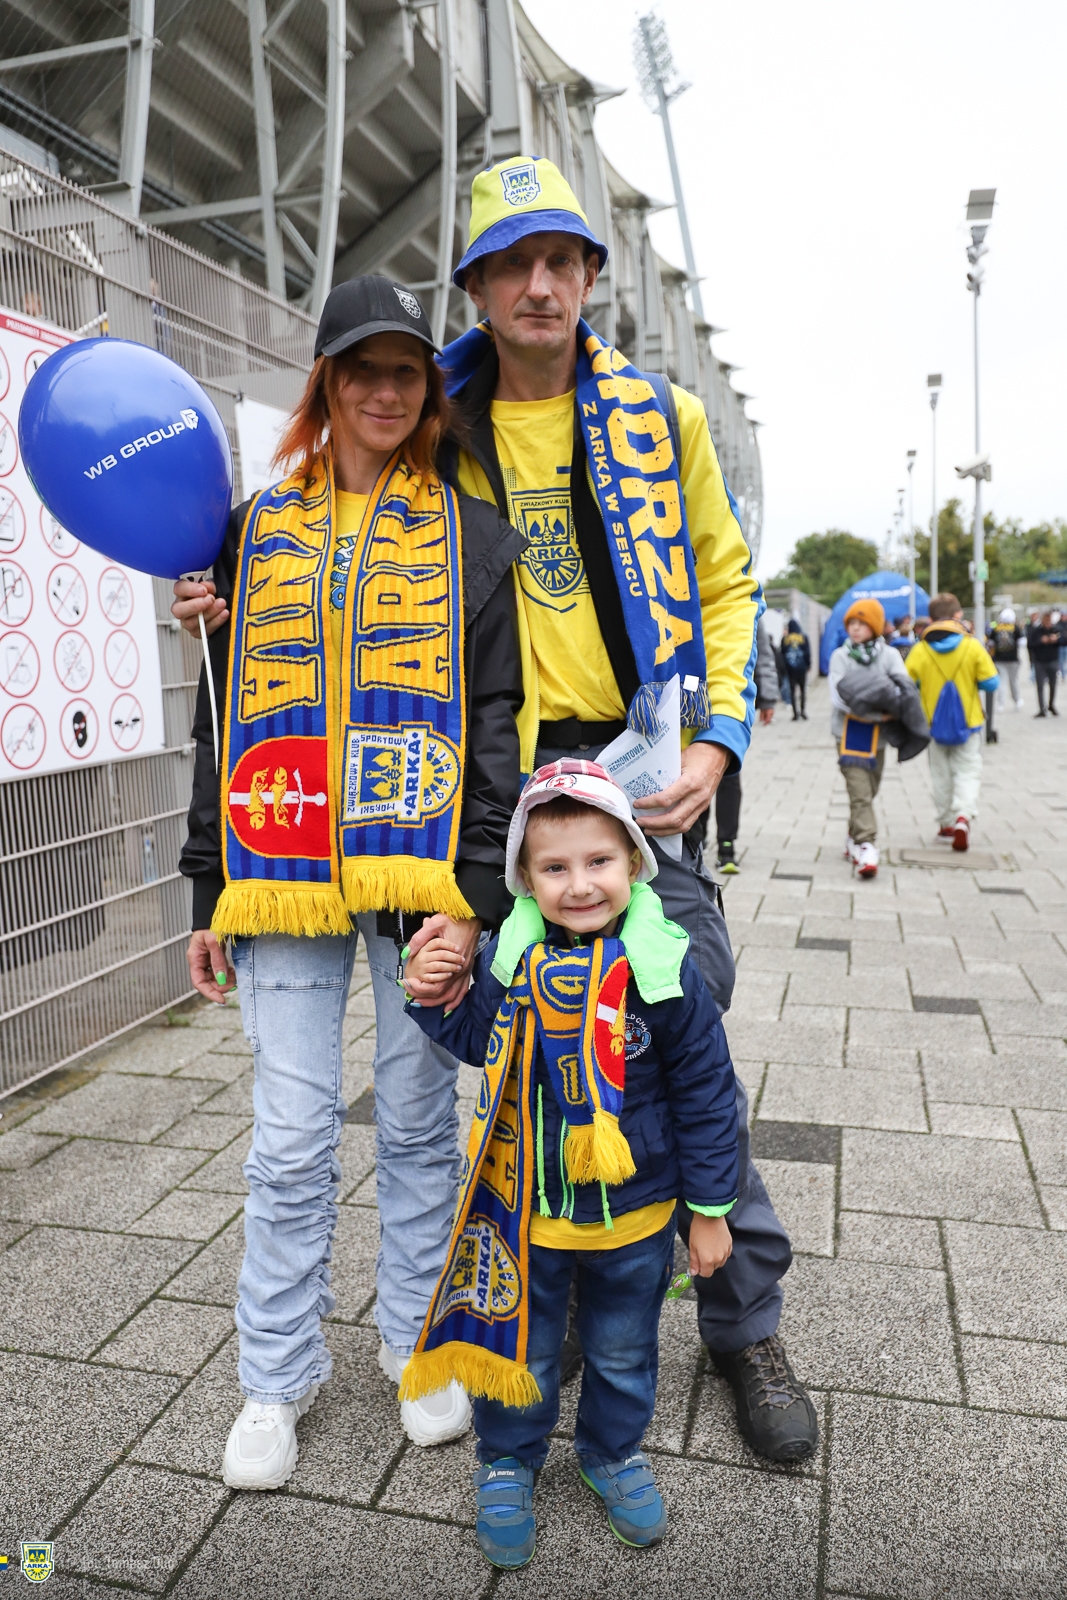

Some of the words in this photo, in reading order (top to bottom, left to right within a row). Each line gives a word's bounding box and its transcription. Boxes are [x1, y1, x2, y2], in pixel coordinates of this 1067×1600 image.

[510, 186, 535, 196] ARKA
[582, 400, 599, 417] Z
[83, 454, 118, 480] WB
[119, 421, 187, 459] GROUP
[586, 424, 614, 491] ARKĄ
[520, 499, 554, 507] ZWIĄZKOWY
[604, 493, 621, 513] W
[529, 546, 577, 560] ARKA
[612, 522, 643, 598] SERCU
[350, 738, 360, 758] KLUB
[360, 733, 409, 746] SPORTOWY
[607, 743, 645, 773] REMONTOWA
[404, 739, 421, 810] ARKA
[360, 802, 396, 815] MORSKI
[477, 1235, 491, 1304] ARKA
